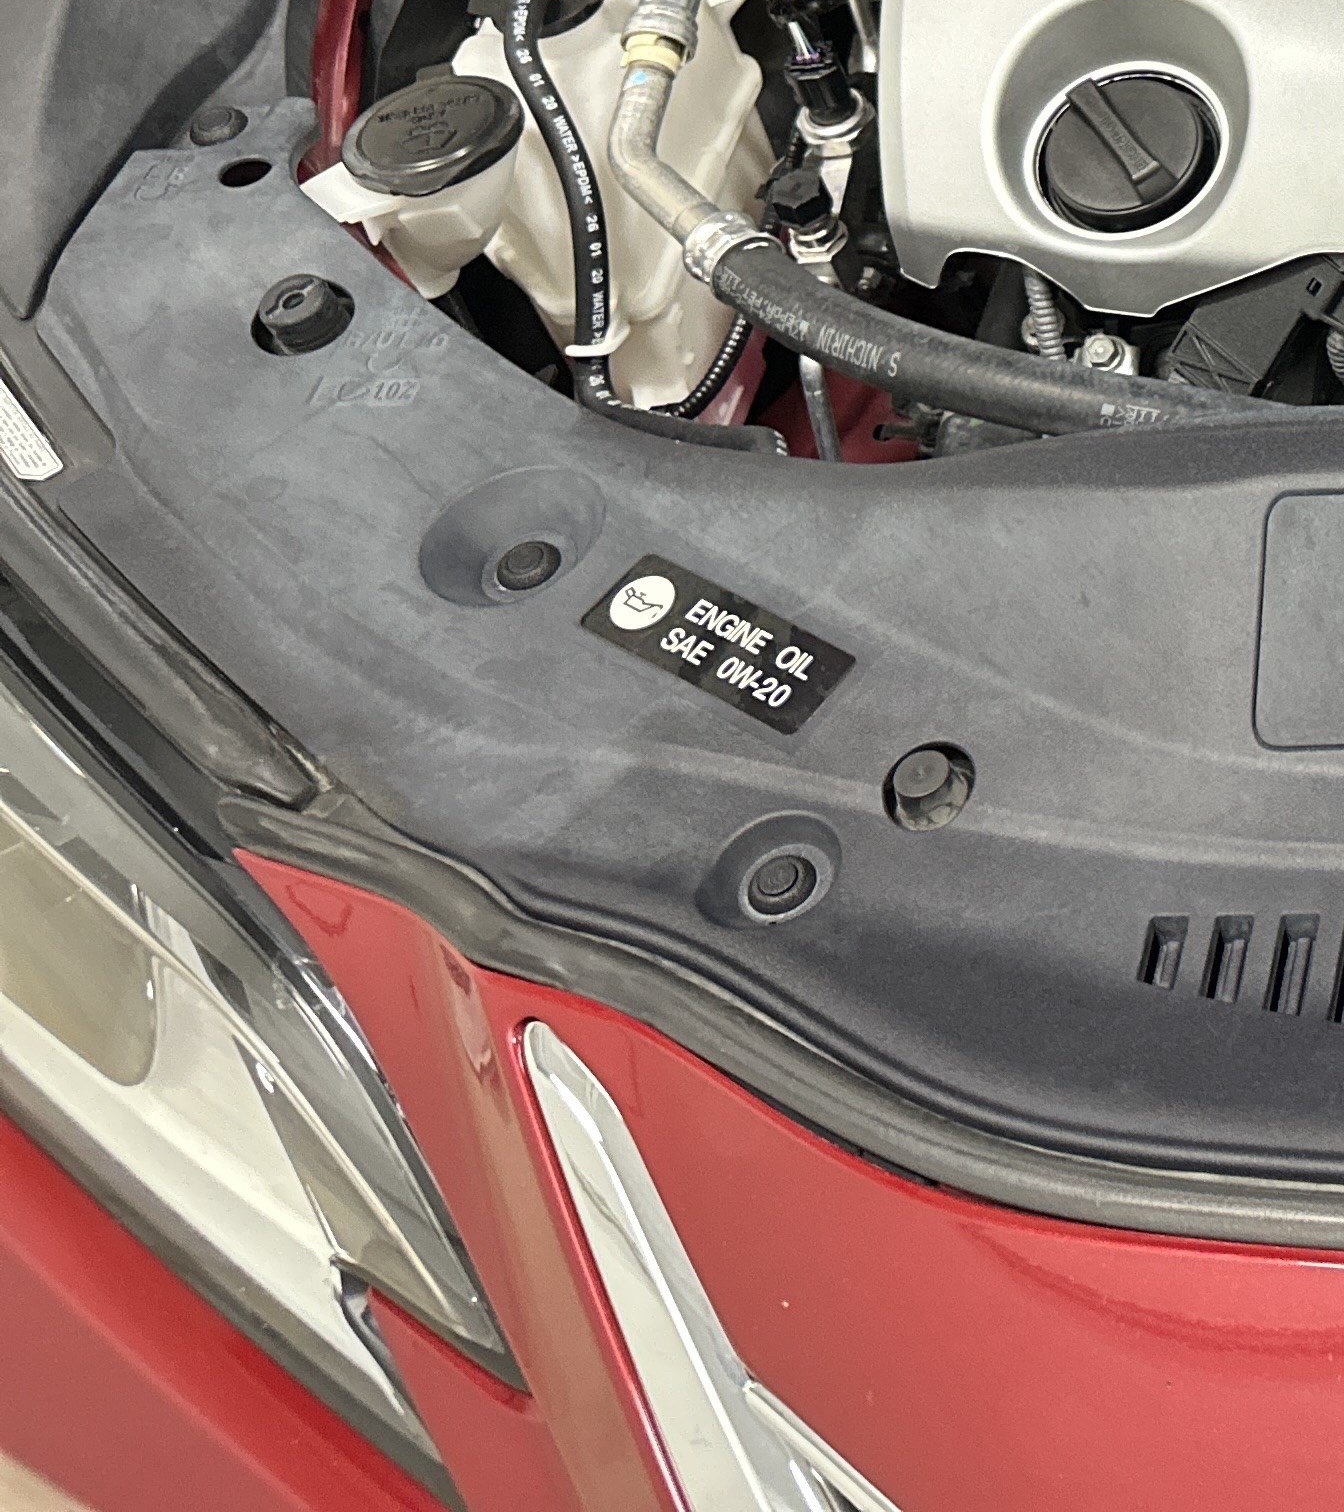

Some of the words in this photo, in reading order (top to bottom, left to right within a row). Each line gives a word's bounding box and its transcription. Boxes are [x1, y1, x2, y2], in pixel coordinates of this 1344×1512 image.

[553, 114, 579, 154] WATER
[585, 213, 600, 234] 26
[588, 241, 603, 258] 01
[591, 290, 606, 330] WATER
[815, 323, 885, 374] NICHIRIN
[886, 349, 902, 378] S
[685, 598, 774, 656] ENGINE
[774, 645, 814, 682] OIL
[660, 627, 715, 666] SAE
[716, 656, 793, 708] 0W-20
